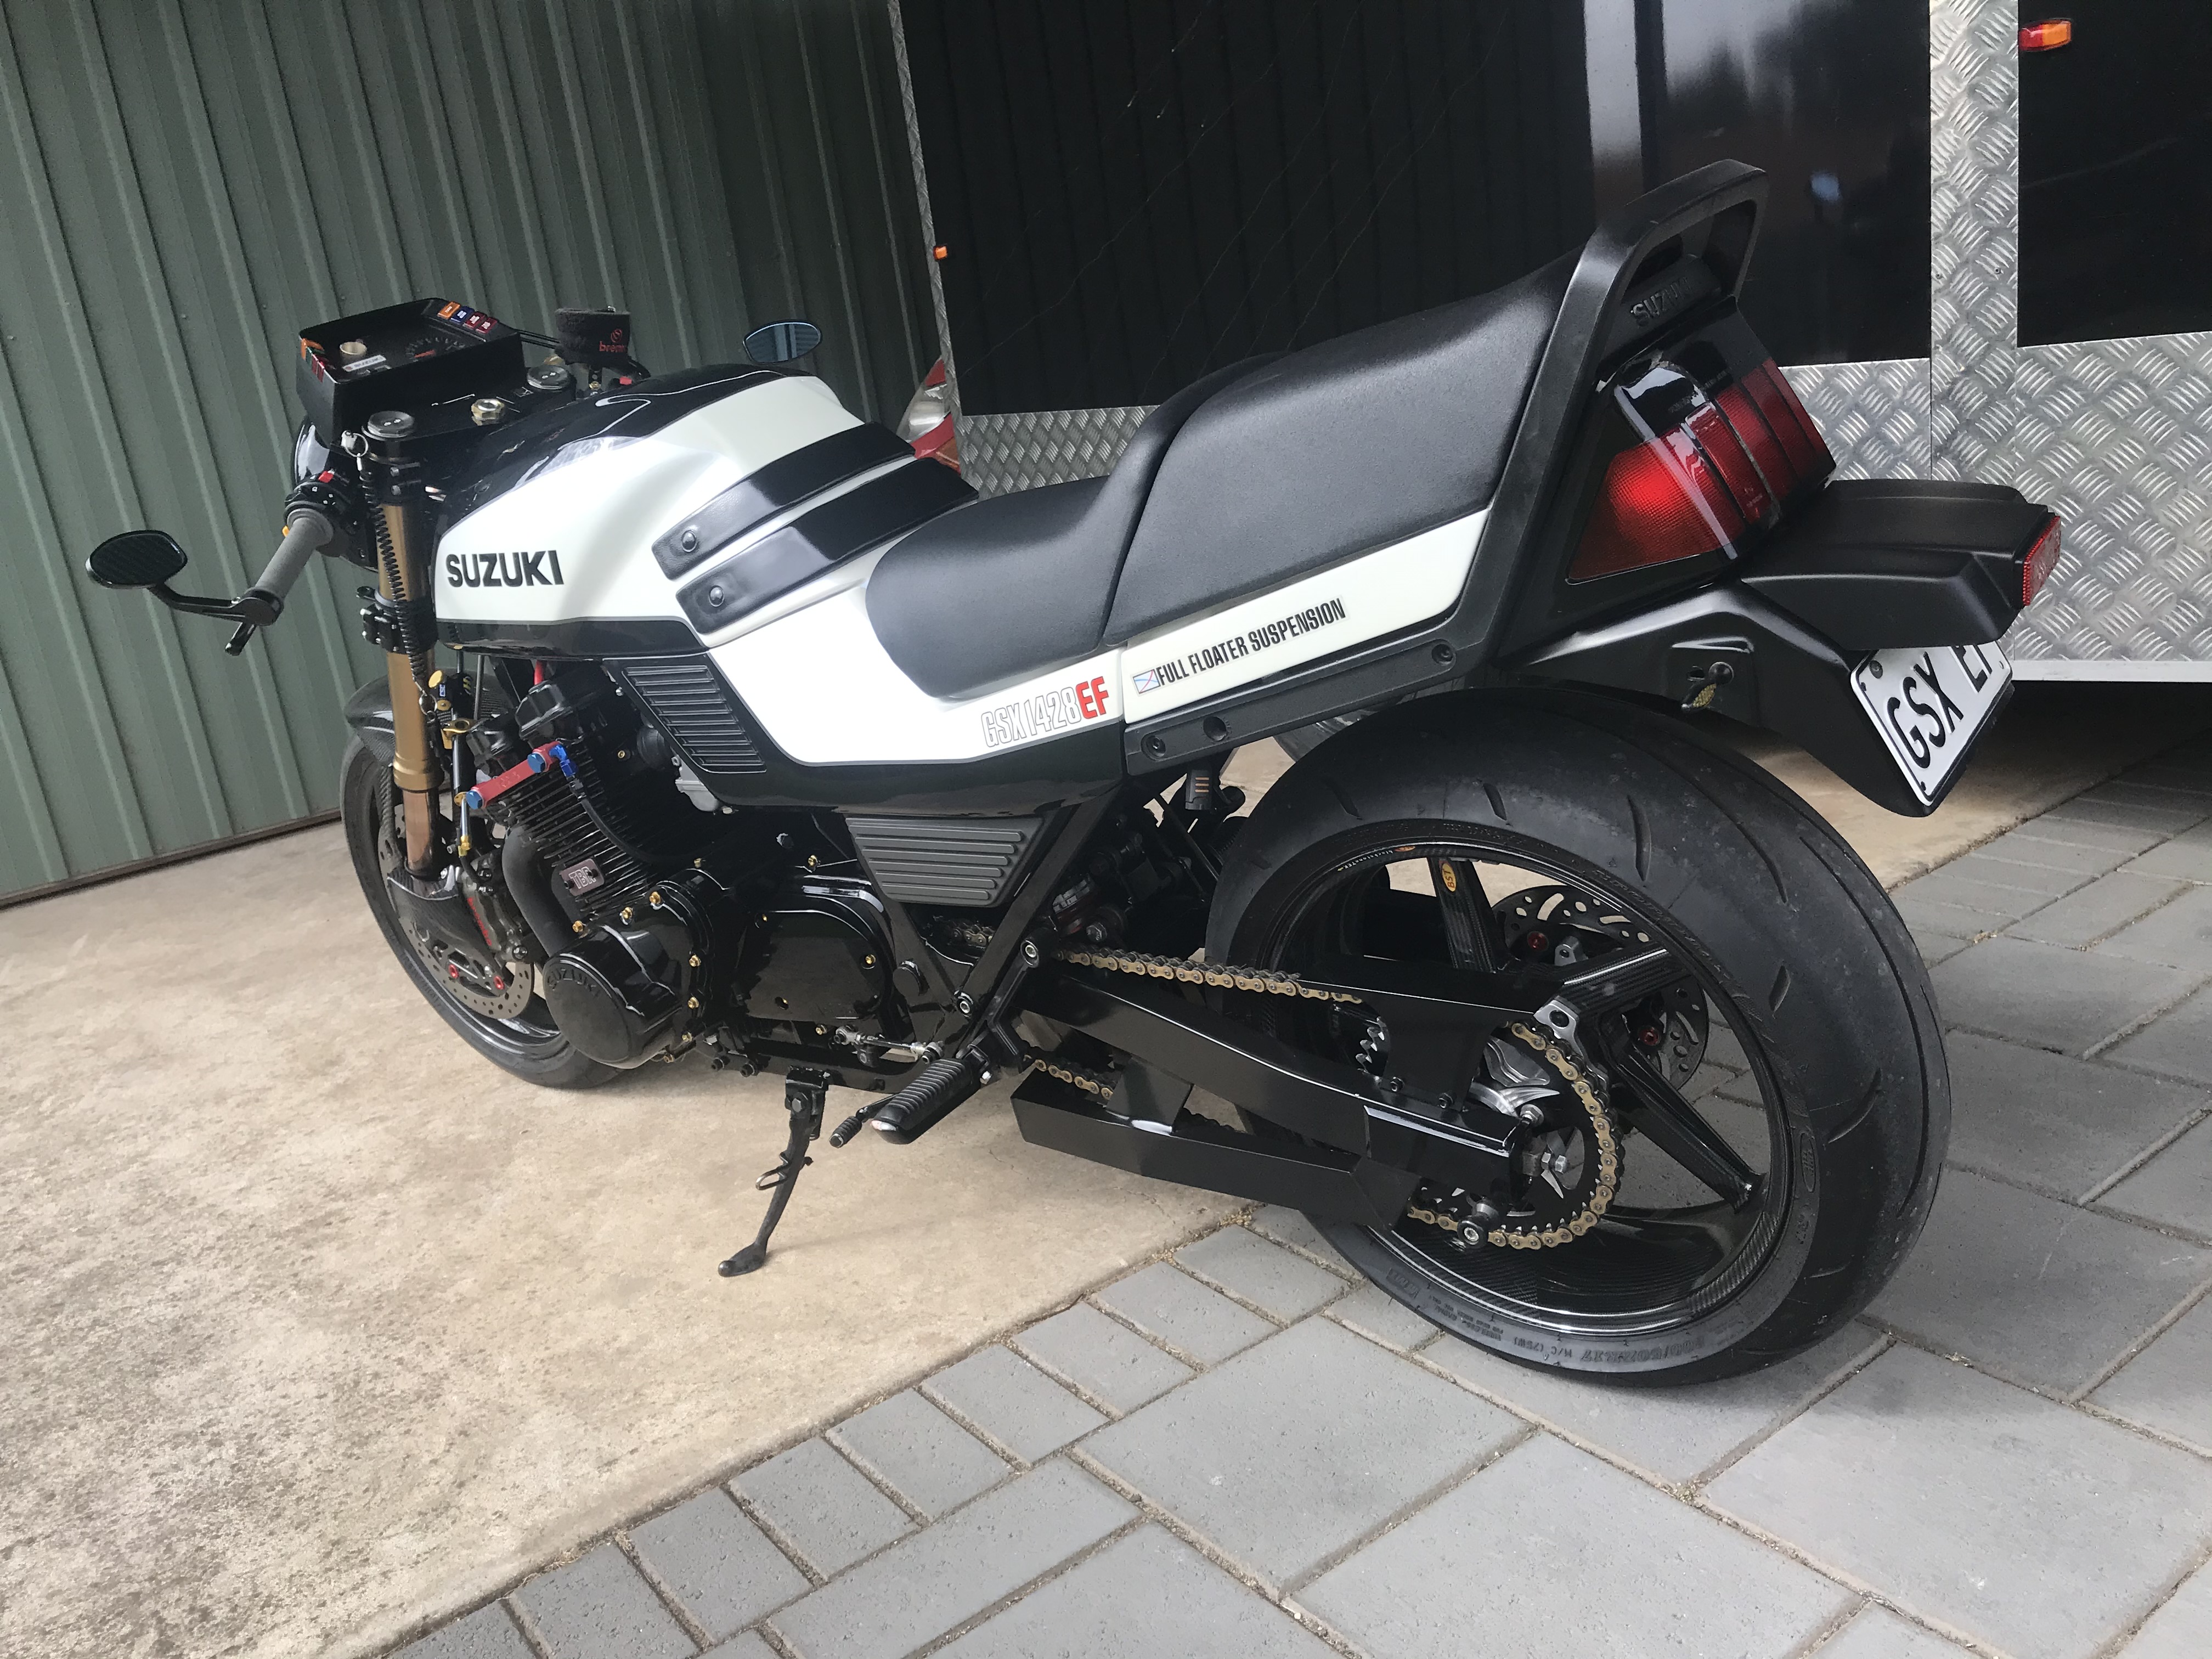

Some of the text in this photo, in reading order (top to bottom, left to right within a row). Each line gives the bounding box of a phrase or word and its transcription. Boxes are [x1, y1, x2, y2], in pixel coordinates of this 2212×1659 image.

[446, 550, 565, 588] SUZUKI
[1156, 597, 1346, 685] FULL FLOATER SUSPENSION
[980, 676, 1110, 747] GSX1428EF
[1887, 651, 1964, 769] GSX
[1444, 870, 1455, 889] BST
[1550, 1346, 1572, 1358] M/C
